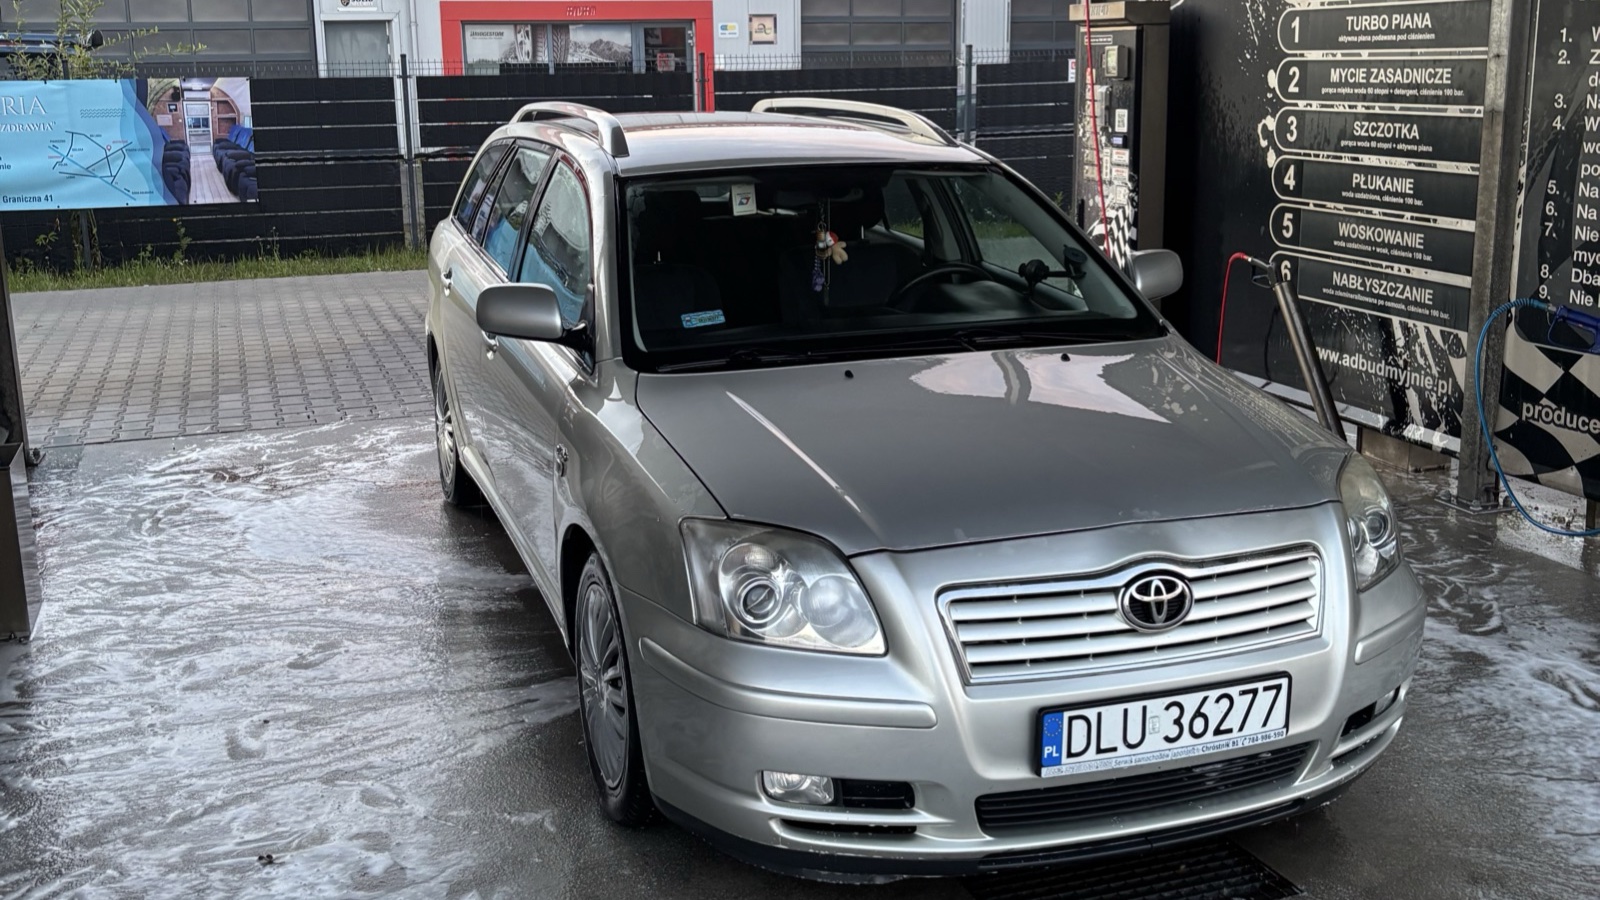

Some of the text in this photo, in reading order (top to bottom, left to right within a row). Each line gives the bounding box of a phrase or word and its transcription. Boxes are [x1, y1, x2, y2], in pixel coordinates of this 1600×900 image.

[1291, 16, 1300, 43] 1
[1346, 12, 1432, 32] TURBO PIANA
[1397, 32, 1407, 41] pod
[1560, 27, 1573, 42] 1.
[1557, 49, 1571, 64] 2.
[1287, 66, 1300, 93] 2
[1330, 68, 1452, 84] MYCIE ZASADNICZE
[1454, 88, 1465, 96] bar.
[1554, 93, 1567, 108] 3.
[1286, 115, 1298, 142] 3
[1353, 121, 1419, 140] SZCZOTKA
[1552, 115, 1565, 130] 4.
[1283, 164, 1296, 190] 4
[1352, 173, 1414, 194] PŁUKANIE
[2, 194, 53, 203] Graniczna 41
[1547, 180, 1600, 199] 5. Na
[1545, 201, 1597, 220] 6. Na
[1281, 212, 1294, 238] 5
[1544, 222, 1599, 242] 7. Nie
[1338, 222, 1425, 249] WOSKOWANIE
[1280, 259, 1292, 282] 6
[1540, 264, 1553, 279] 8.
[1332, 270, 1434, 305] NABŁYSZCZANIE
[1539, 285, 1593, 307] 9. Nie
[1066, 683, 1283, 759] DLU 36277
[1044, 745, 1060, 759] PL
